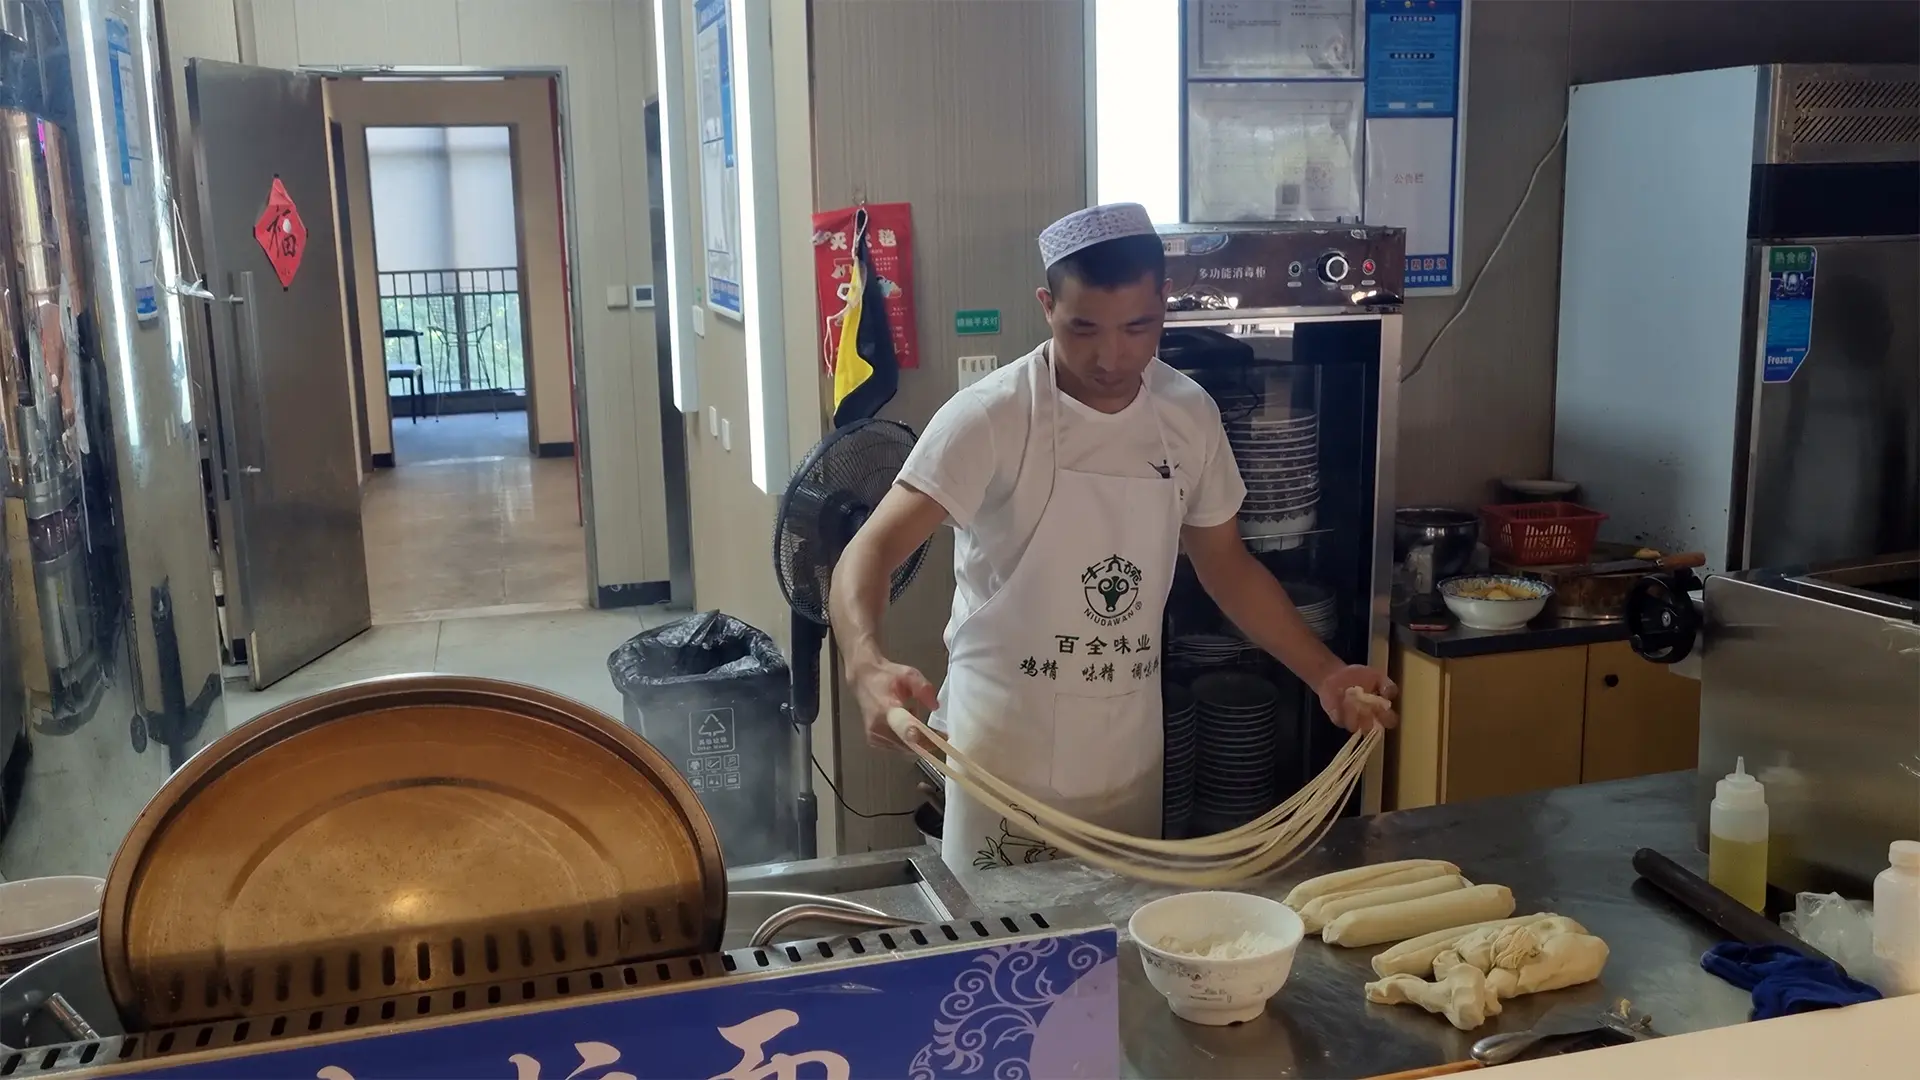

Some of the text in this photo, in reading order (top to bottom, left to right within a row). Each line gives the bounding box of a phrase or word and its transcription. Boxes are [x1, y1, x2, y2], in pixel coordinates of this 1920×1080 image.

[1393, 172, 1424, 185] 公告栏
[266, 204, 297, 258] 福
[830, 228, 897, 251] 灭毯
[1199, 266, 1266, 280] 多功能消毒柜
[1767, 355, 1794, 365] Frozen
[1081, 553, 1142, 586] 牛大碗
[1083, 608, 1135, 627] NIUDAWAN
[1055, 633, 1151, 656] 百全味业
[1019, 656, 1059, 681] 鸡精
[1081, 662, 1116, 683] 味精
